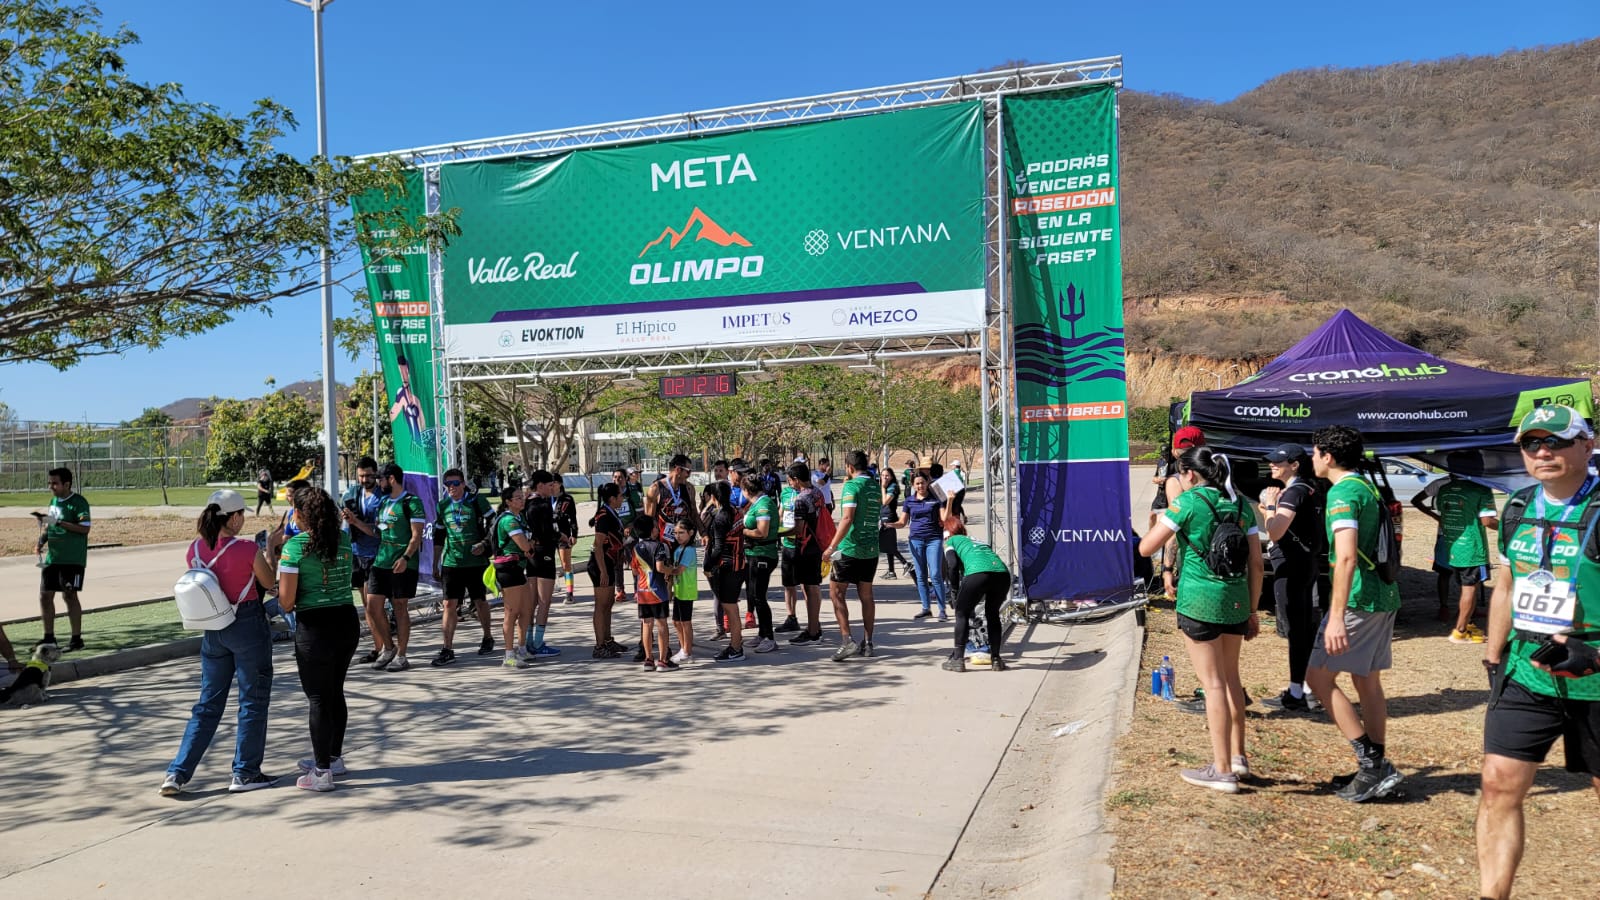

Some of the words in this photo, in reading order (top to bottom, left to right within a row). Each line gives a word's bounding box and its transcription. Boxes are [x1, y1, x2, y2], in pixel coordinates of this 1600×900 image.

[650, 152, 758, 191] META
[1015, 174, 1094, 195] VENCER
[1097, 173, 1110, 186] A
[1014, 190, 1115, 213] POSEIDÓN
[1037, 215, 1063, 229] EN
[1066, 212, 1092, 226] LA
[836, 221, 951, 250] VENTANA
[1036, 248, 1097, 266] FASE?
[467, 256, 522, 285] Valle
[523, 251, 580, 281] Real
[629, 255, 765, 285] OLIMPO
[382, 289, 411, 300] HAS
[392, 318, 426, 329] FASE
[848, 308, 918, 326] AMEZCO
[521, 325, 585, 343] EVOKTION
[615, 322, 629, 335] El
[632, 320, 677, 337] Hípico
[1288, 363, 1448, 382] cronohub
[1305, 378, 1366, 386] medimos
[1234, 403, 1312, 417] cronohub
[1356, 409, 1468, 420] www.cronohub.com
[1050, 529, 1126, 542] VENTANA
[1509, 539, 1579, 557] OLIPO
[1517, 592, 1566, 614] 067
